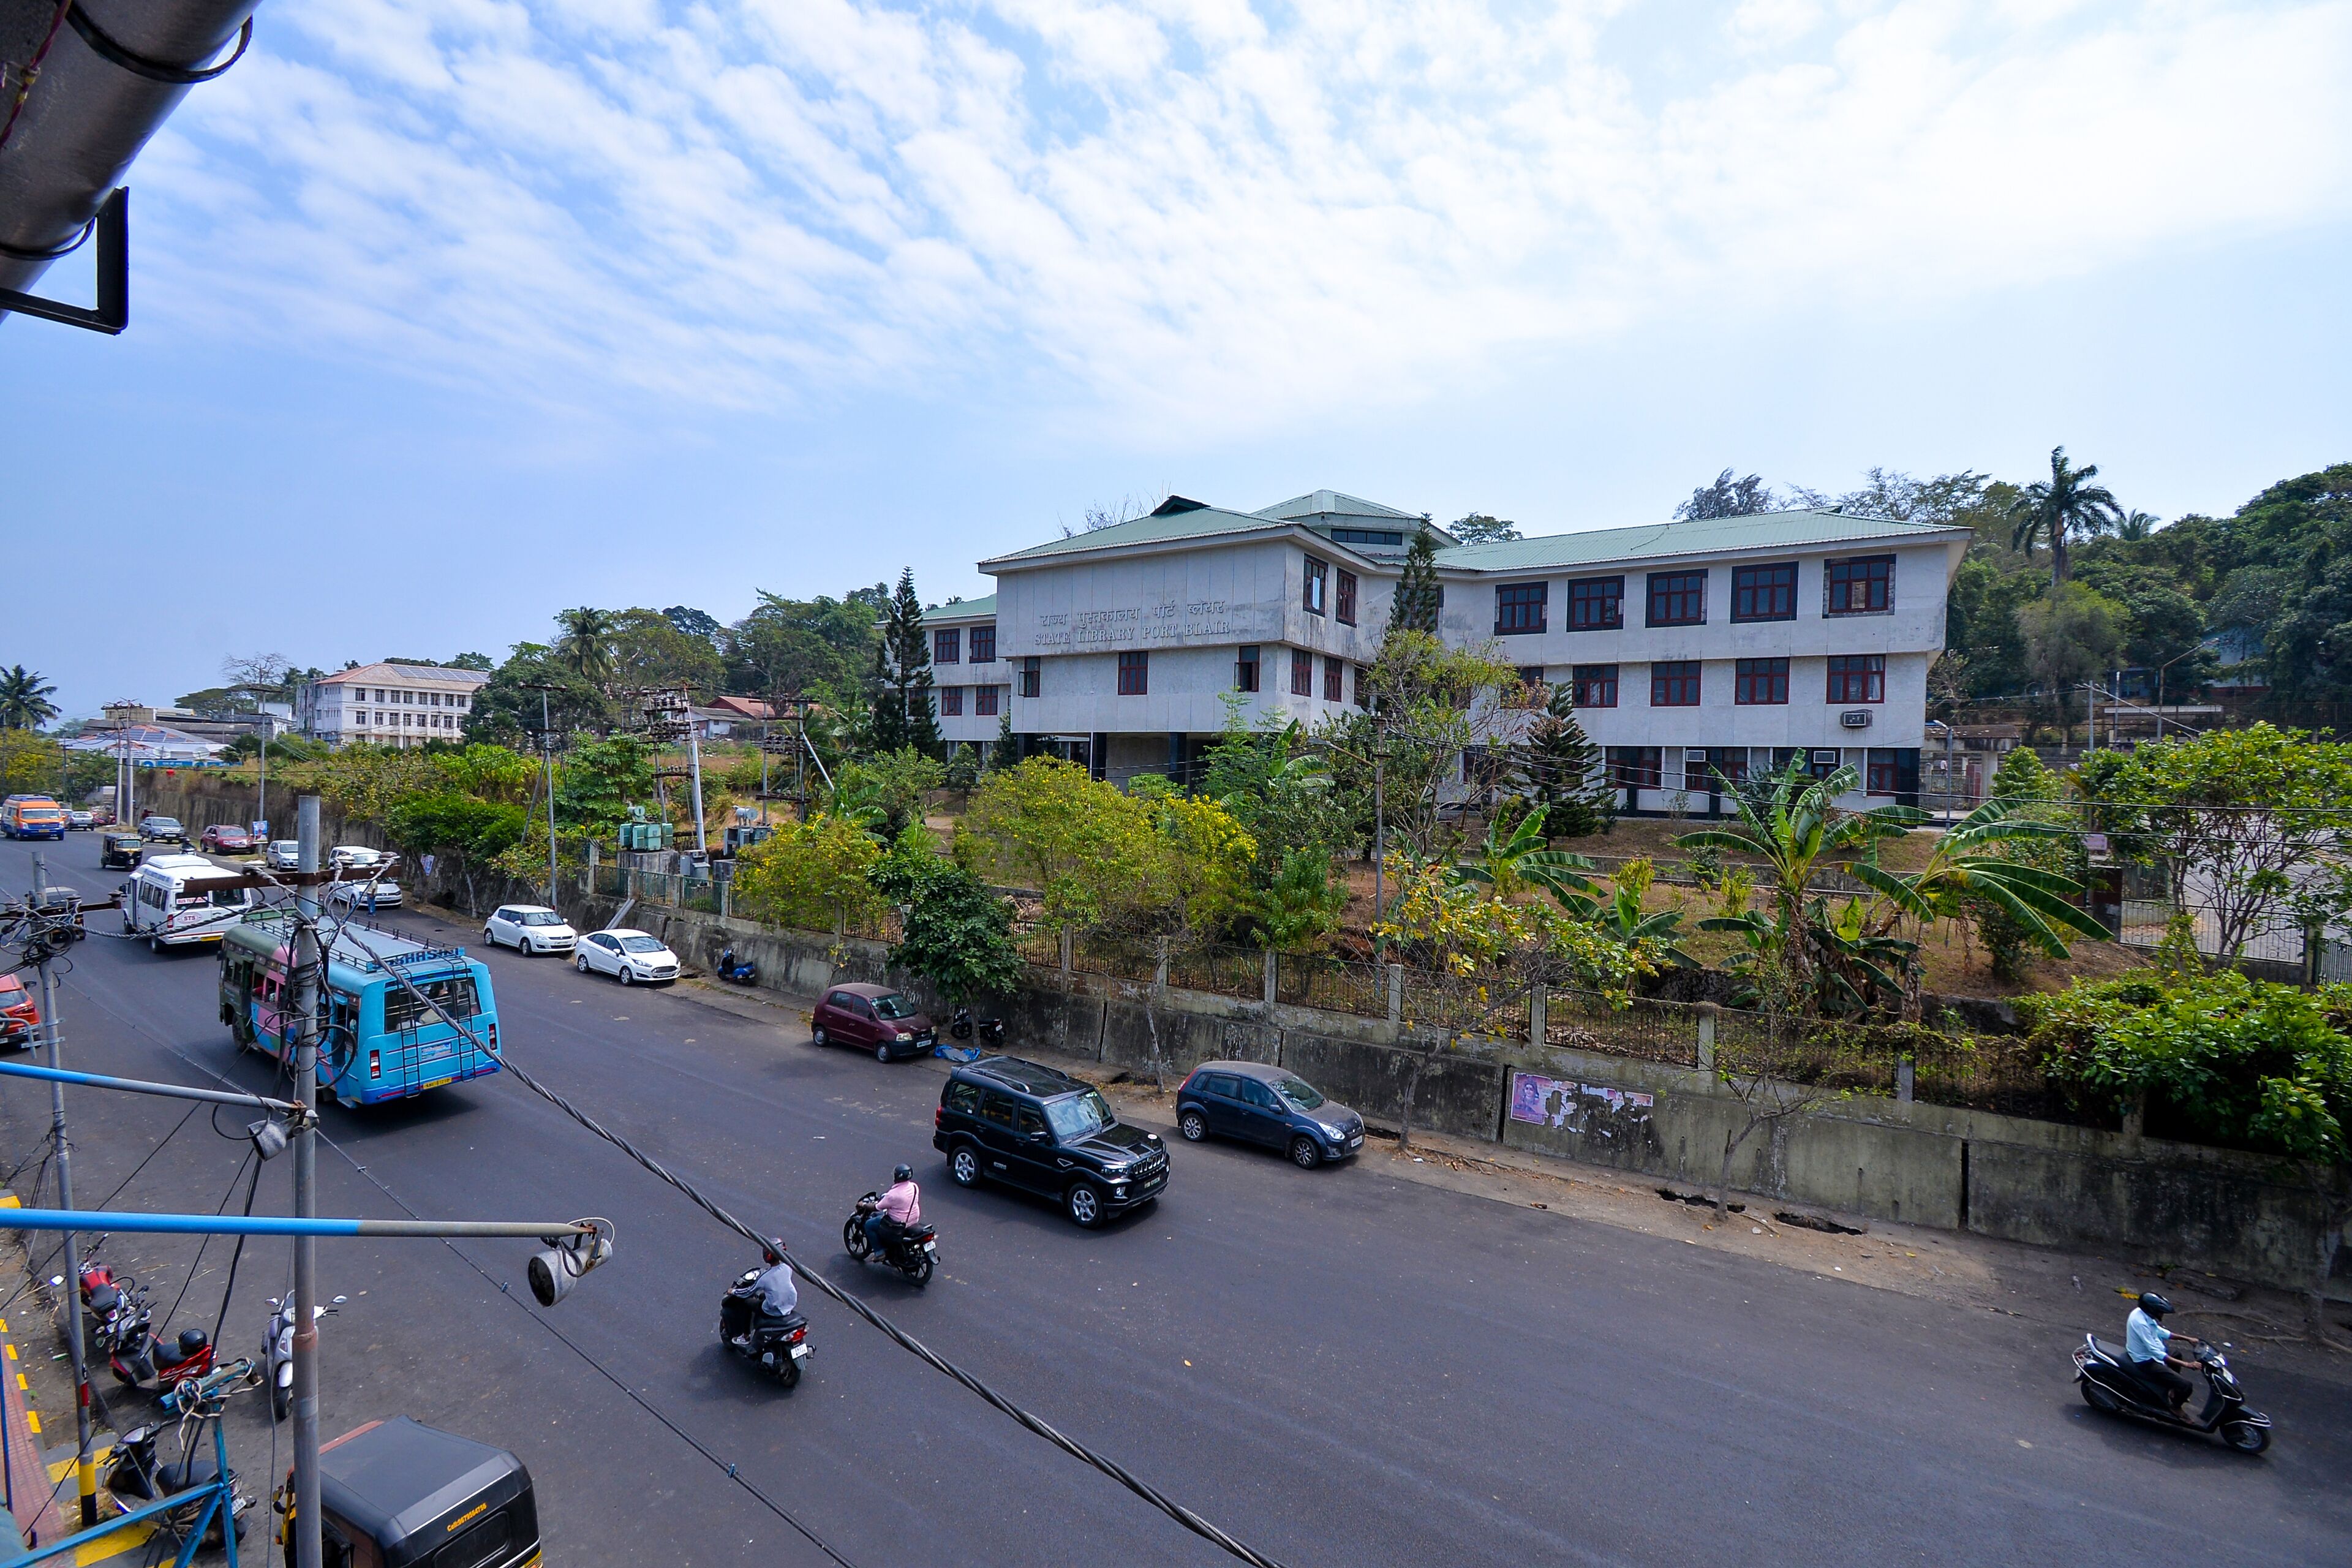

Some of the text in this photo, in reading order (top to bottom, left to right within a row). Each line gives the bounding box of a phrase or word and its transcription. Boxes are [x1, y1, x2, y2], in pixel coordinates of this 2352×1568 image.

[1040, 597, 1225, 629] राज्य पुस्तकालय पोर्ट ब्लेयर
[1035, 620, 1230, 645] STATE LIBRARY PORT BLAIR
